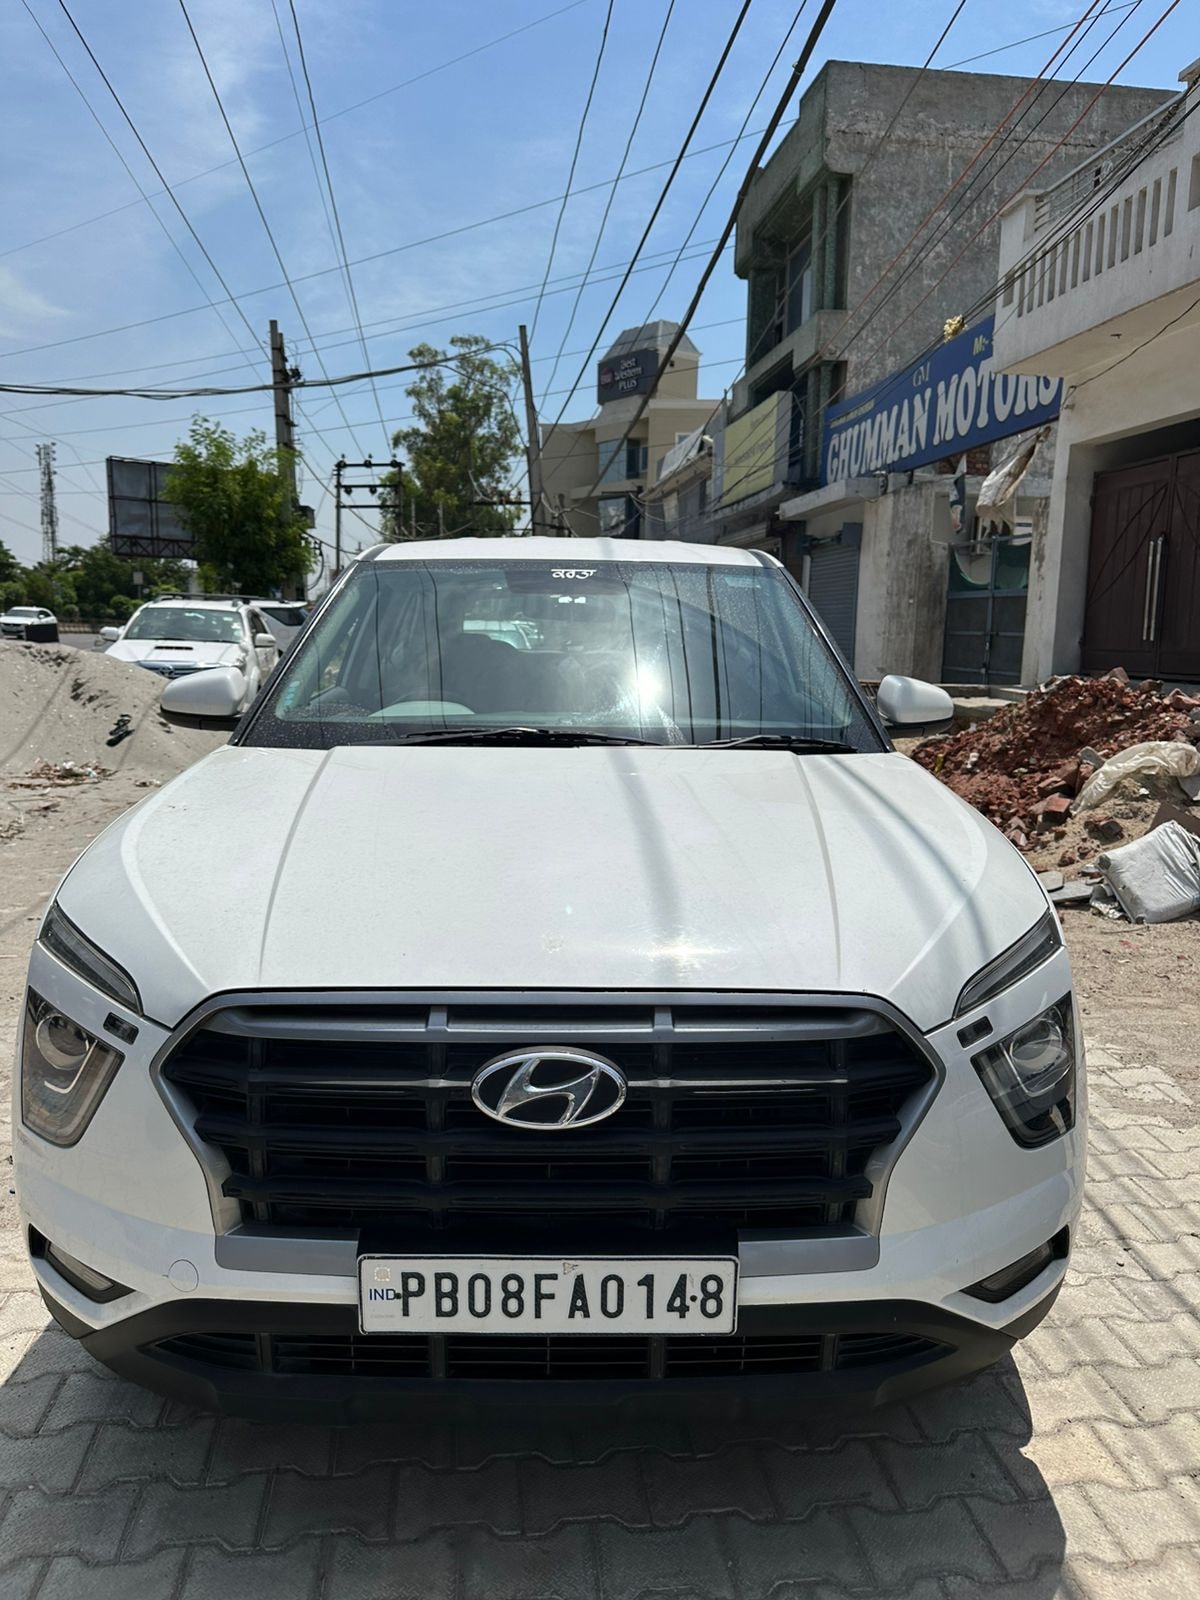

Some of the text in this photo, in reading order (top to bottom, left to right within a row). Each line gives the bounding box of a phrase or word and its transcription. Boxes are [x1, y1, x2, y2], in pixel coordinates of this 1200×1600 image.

[912, 361, 930, 387] GM
[826, 387, 932, 485] GHUMMAN
[369, 1288, 396, 1301] IND
[400, 1271, 725, 1319] PB08FA0148
